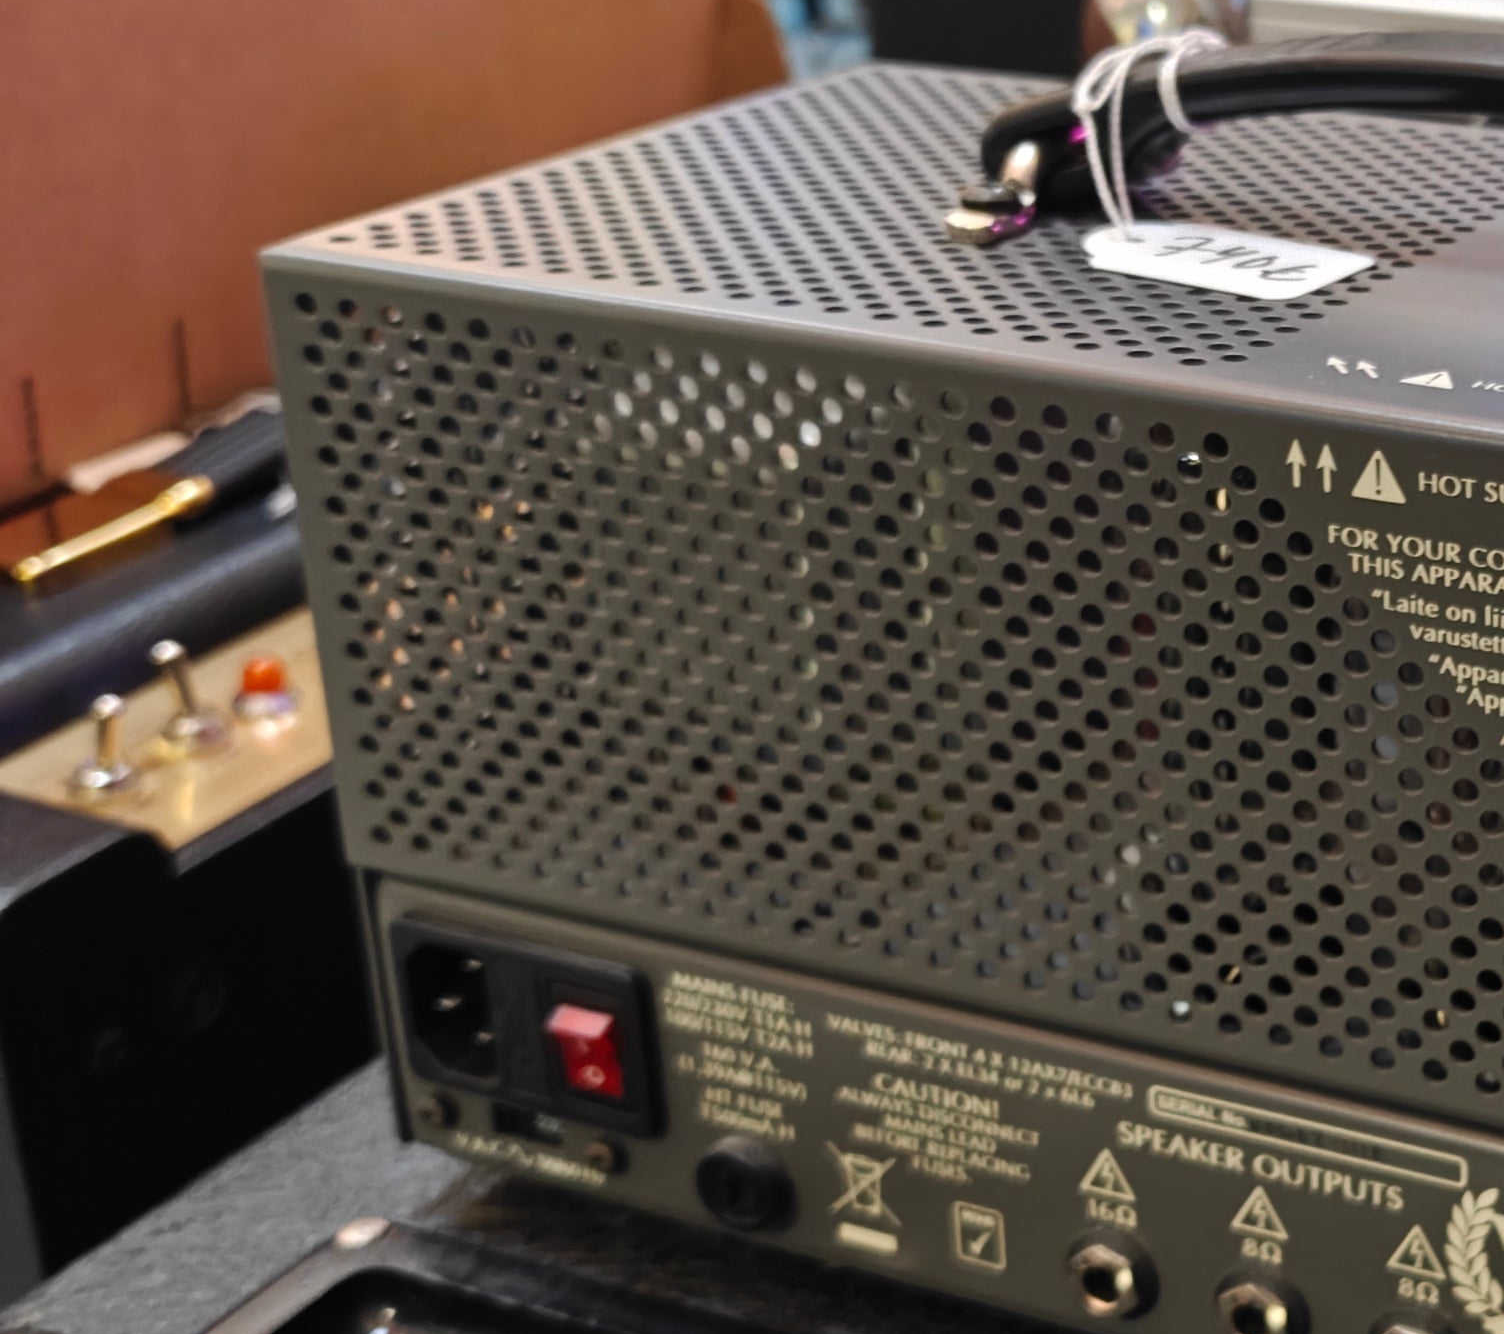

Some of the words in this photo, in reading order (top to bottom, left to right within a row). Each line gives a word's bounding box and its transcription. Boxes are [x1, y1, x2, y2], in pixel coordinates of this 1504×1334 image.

[1418, 471, 1477, 499] HOT
[1328, 523, 1378, 551] FOR
[1386, 533, 1461, 564] YOUR
[1347, 552, 1405, 580] THIS
[873, 1072, 999, 1119] CAUTION!
[1117, 1120, 1244, 1172] SPEAKER
[1252, 1153, 1404, 1211] OUTPUTS
